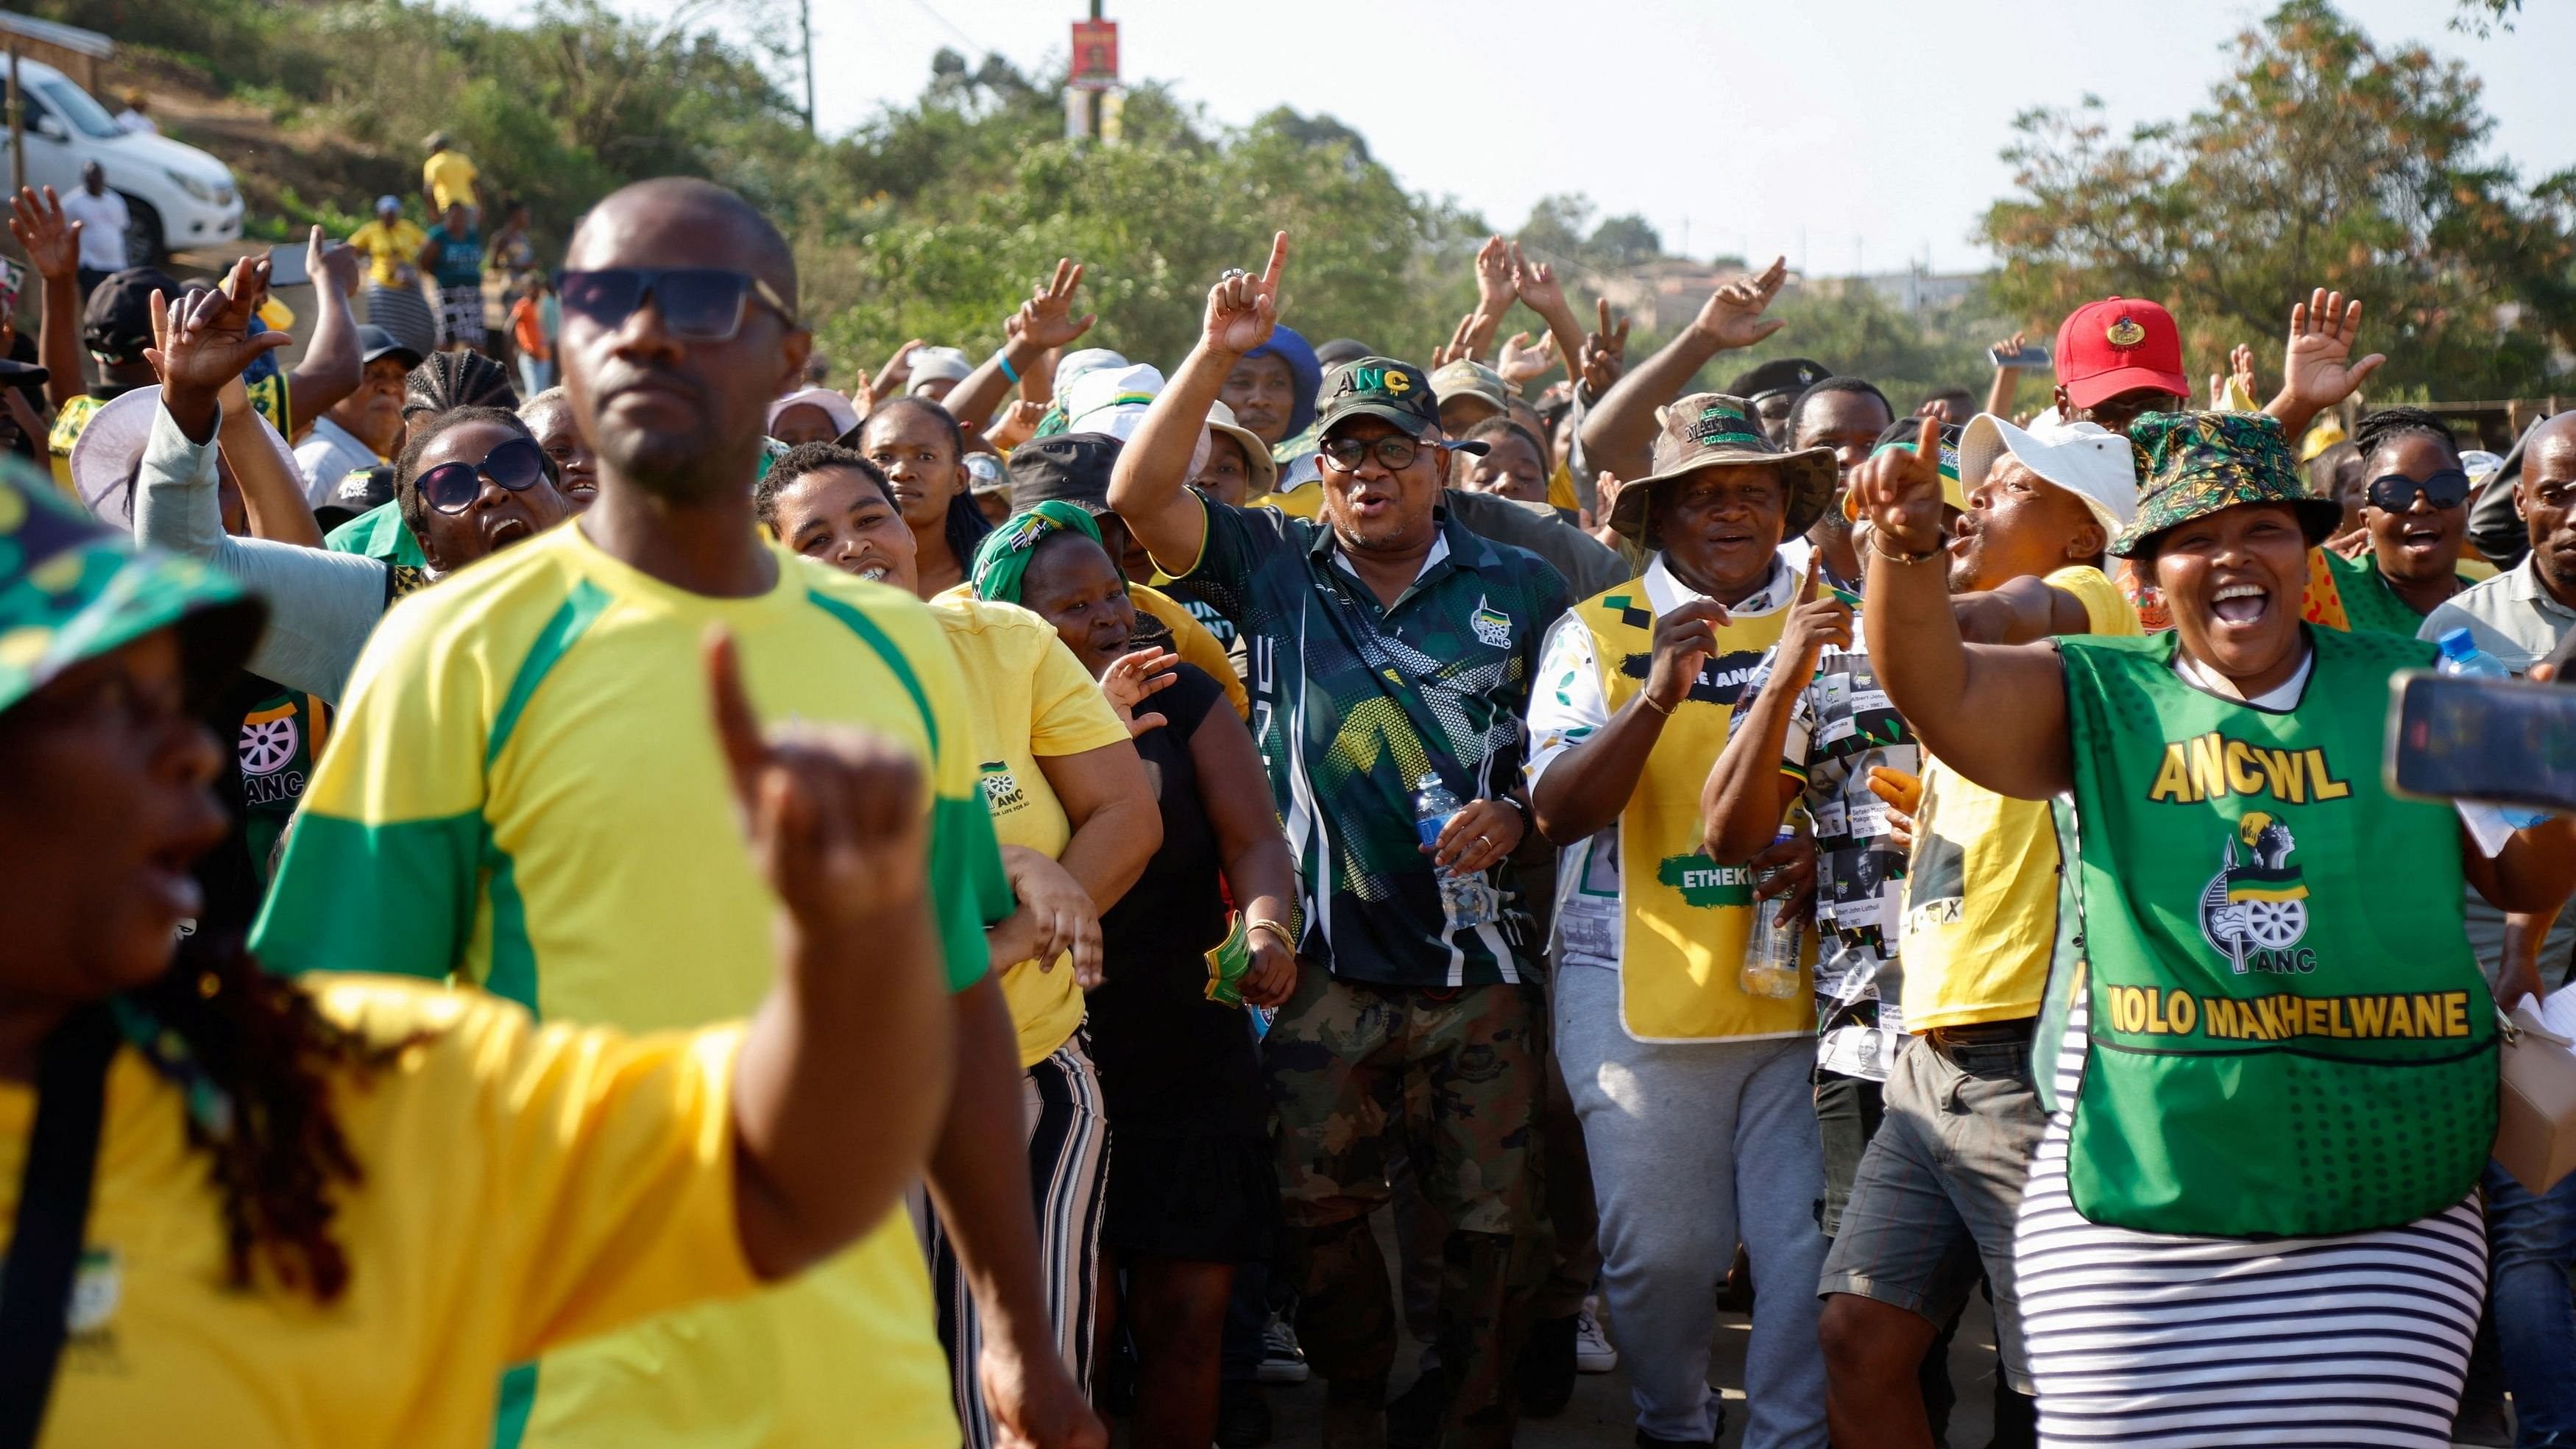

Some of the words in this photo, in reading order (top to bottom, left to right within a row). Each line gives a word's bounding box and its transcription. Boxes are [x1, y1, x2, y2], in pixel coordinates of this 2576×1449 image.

[1333, 368, 1411, 397] ANC
[1941, 456, 1959, 470] ANC
[345, 488, 369, 498] ANC
[1486, 634, 1512, 649] ANC
[2148, 731, 2354, 805] ANCWL
[244, 770, 305, 806] ANC
[997, 788, 1024, 808] ANC
[2255, 948, 2317, 974] ANC
[2203, 991, 2470, 1042] MAKHELWANE
